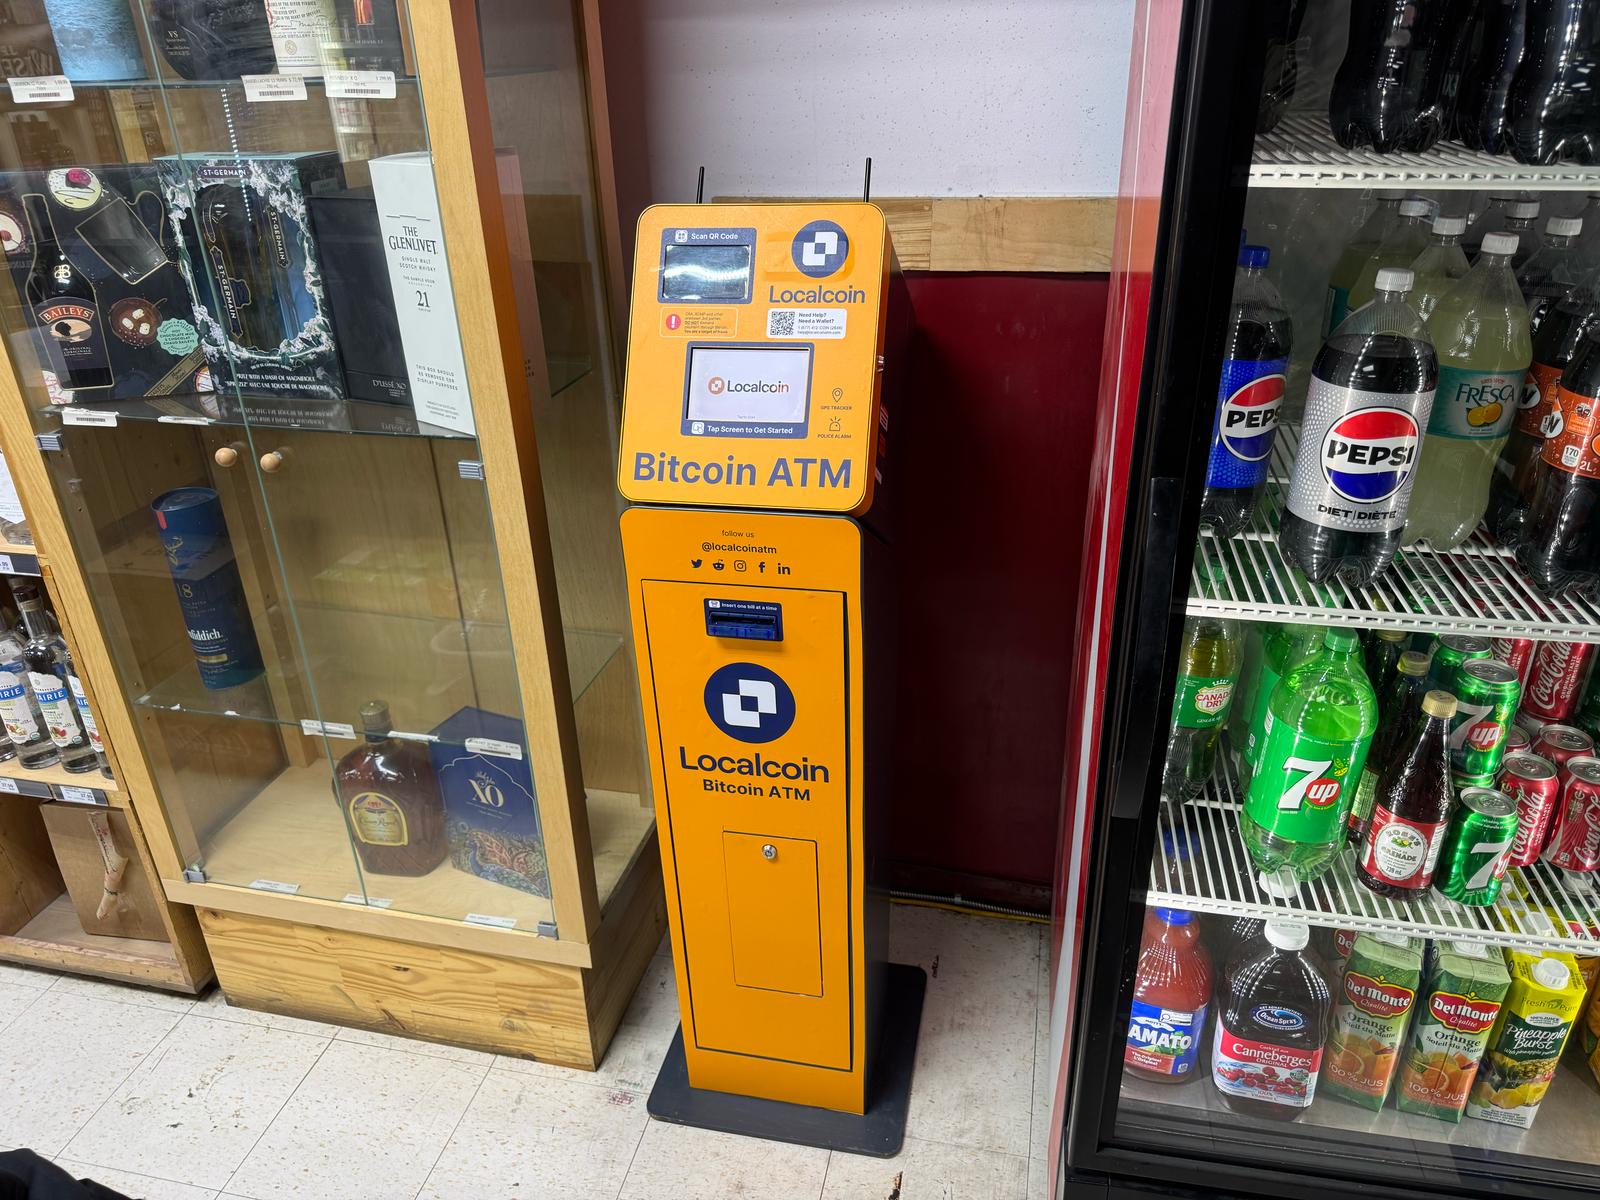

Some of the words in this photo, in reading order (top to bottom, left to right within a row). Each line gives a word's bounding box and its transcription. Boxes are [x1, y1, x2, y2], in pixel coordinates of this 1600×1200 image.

[270, 211, 285, 261] ST-GERMAIN
[402, 226, 418, 237] THE
[388, 236, 437, 255] GLENLIVET
[217, 264, 236, 320] ST-GERMAIN
[416, 290, 430, 308] 21
[769, 285, 865, 304] Localcoin
[43, 307, 91, 320] BAILEYS
[727, 380, 789, 393] Localcoin
[1455, 383, 1515, 407] FRESCA
[1226, 405, 1281, 428] PEPS
[1327, 439, 1415, 466] PEPSI
[1565, 446, 1579, 458] 170
[633, 452, 758, 487] Bitcoin
[767, 457, 852, 488] ATM
[1580, 461, 1593, 472] 2L
[1318, 504, 1353, 520] DIET
[721, 530, 744, 538] follow
[701, 542, 777, 554] @localcoinatm
[0, 688, 21, 698] IRIE
[36, 690, 64, 701] AIRIE
[1470, 725, 1500, 746] up
[679, 746, 830, 783] Localcoin
[468, 779, 504, 808] XO
[703, 778, 763, 796] Bitcoin
[768, 786, 811, 801] ATM
[1308, 783, 1339, 803] up
[1338, 934, 1351, 950] De
[1347, 978, 1366, 997] Del
[1367, 986, 1410, 1007] Monte
[1260, 1013, 1279, 1023] Ocean
[1434, 997, 1456, 1015] Del
[1456, 1006, 1498, 1022] Monte
[1348, 1012, 1393, 1033] Orange
[1128, 1024, 1192, 1049] AMATO
[1426, 1035, 1448, 1046] Soleil
[1434, 1030, 1481, 1047] Orange
[1507, 1024, 1567, 1041] Pineapple
[1513, 1038, 1554, 1050] Burst
[1140, 1054, 1162, 1062] Original
[1232, 1043, 1312, 1067] Canneberges
[1256, 1058, 1287, 1068] ORIGINAL
[1328, 1062, 1346, 1077] 100
[1360, 1077, 1384, 1087] JUS
[1408, 1082, 1429, 1095] 100
[1444, 1092, 1466, 1101] JUS
